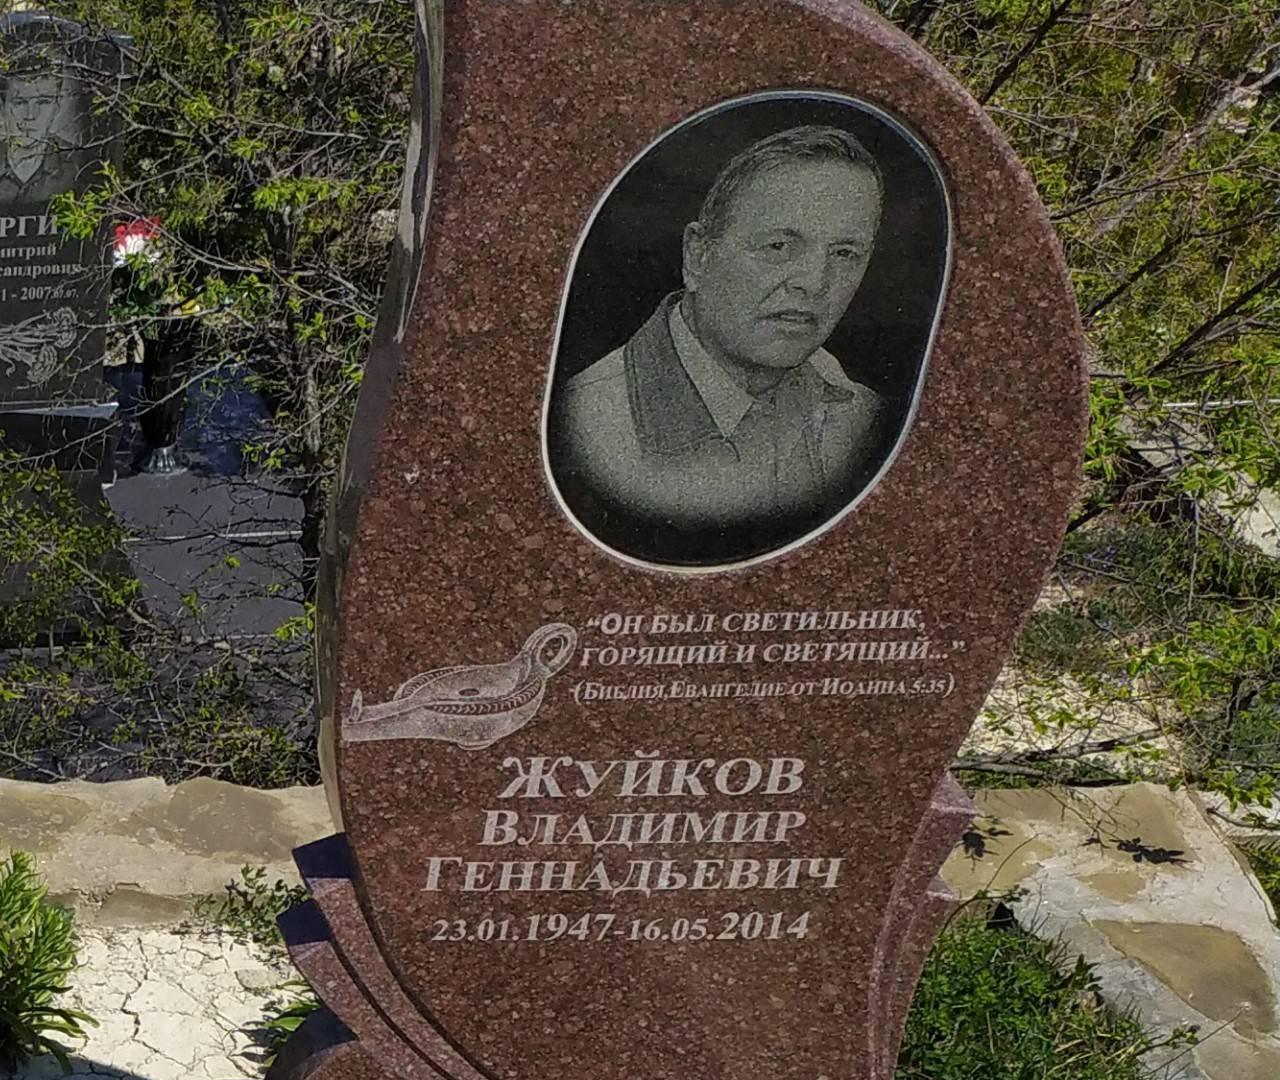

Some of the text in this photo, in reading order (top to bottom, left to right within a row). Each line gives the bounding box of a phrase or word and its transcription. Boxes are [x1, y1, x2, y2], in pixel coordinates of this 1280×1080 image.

[650, 613, 715, 635] БЫЛ
[722, 609, 927, 634] СВЕТИЛЬНИК,
[580, 639, 728, 667] ГОРЯЩИЙ
[732, 644, 755, 664] И
[910, 672, 956, 699] 5:35)
[496, 750, 806, 799] ЖУЙКОВ
[477, 808, 807, 851] ВЛАДИМИР
[420, 856, 846, 898] ГЕННАДЬЕВИЧ
[430, 911, 811, 942] 23.01.1947-16.05.2014
